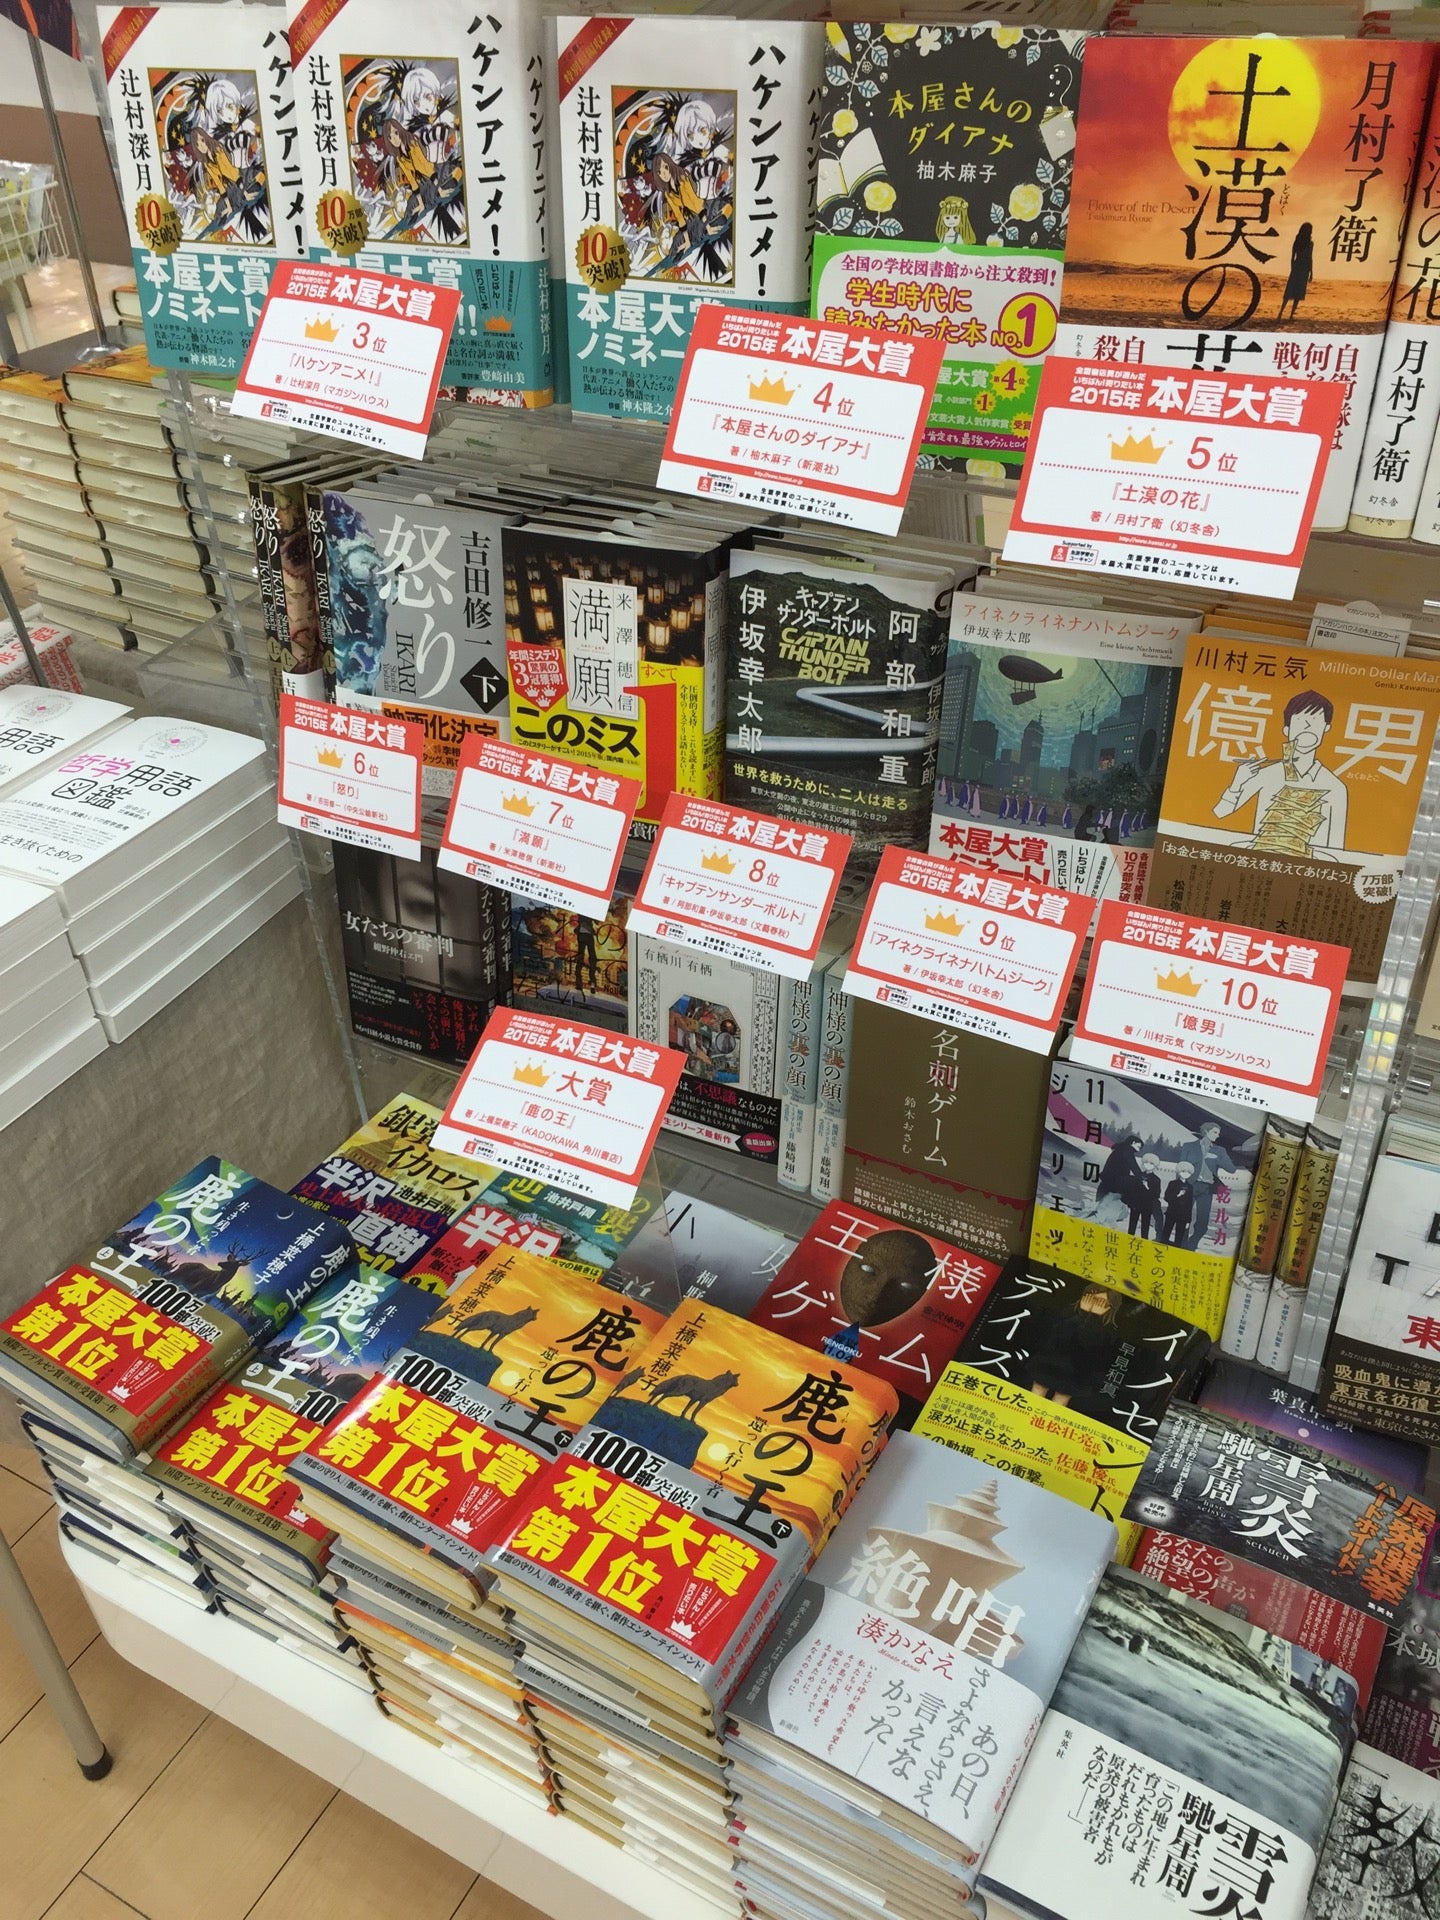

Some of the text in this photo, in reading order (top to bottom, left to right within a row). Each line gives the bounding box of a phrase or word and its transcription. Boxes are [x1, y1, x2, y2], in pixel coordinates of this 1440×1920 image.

[309, 55, 340, 187] 辻村深月
[888, 82, 1032, 124] 本屋さんの
[119, 69, 151, 191] 辻村深月
[467, 14, 506, 257] ハケンアニメ!
[526, 54, 546, 254] ハケンアニメ!
[576, 87, 604, 223] 辻村深月
[909, 121, 1015, 155] ダイアナ
[748, 45, 786, 296] ハケンアニメ!
[917, 159, 996, 183] 柚木麻子
[1328, 60, 1397, 263] 月村了衛
[1088, 200, 1197, 215] Flower of the Desert
[141, 255, 272, 297] 本屋大賞
[586, 257, 628, 286] 突破!
[841, 253, 1056, 286] 全国の学校図書館から注文殺到!
[846, 277, 972, 312] 学生時代に
[286, 277, 436, 321] 2015年 本屋大賞
[352, 322, 387, 354] 3位
[717, 326, 915, 378] 2015年 本屋大賞
[289, 352, 383, 388] 『ハケンアニメ!』
[812, 381, 855, 417] 4位
[1069, 377, 1308, 425] 2015年 本屋大賞
[1373, 339, 1428, 483] 月村了衛
[712, 413, 870, 460] 『本屋さんのダイアナ』
[1186, 436, 1238, 473] 5位
[250, 495, 265, 546] 怒り
[1111, 482, 1210, 513] 『土漠の花』
[263, 505, 281, 556] 怒り
[307, 507, 326, 559] 怒り
[259, 559, 272, 598] IKARI
[272, 568, 286, 611] IKARI
[317, 571, 329, 615] IKARI
[460, 530, 493, 647] 吉田修一
[795, 585, 860, 615] キャプテン
[375, 514, 455, 699] 怒り
[964, 602, 1180, 640] アイネクライネナハトムジーク
[508, 649, 560, 661] 年間ミステリ
[568, 586, 614, 711] 満願
[616, 591, 634, 712] 米澤穂信
[779, 642, 871, 674] THUNDER
[781, 627, 869, 656] CAPTAIN
[963, 624, 1031, 644] 伊坂幸太郎
[395, 630, 417, 697] IKARI
[471, 674, 498, 704] 下
[737, 584, 767, 755] 伊坂幸太郎
[797, 664, 849, 685] BOLT
[1196, 646, 1311, 680] 川村元気
[878, 610, 920, 785] 阿部和重
[294, 712, 406, 750] 2015年 本屋大賞
[515, 706, 641, 759] このミス
[921, 685, 942, 785] 伊坂幸太郎
[58, 753, 202, 797] 哲学用語
[353, 752, 380, 778] 6位
[479, 755, 620, 806] 2015年 本屋大賞
[733, 763, 908, 811] 世界を救うために、二人は走る
[51, 777, 133, 811] 図鑑
[549, 801, 574, 829] 7位
[681, 814, 726, 836] 2015年
[728, 815, 828, 862] 本屋大賞
[939, 823, 1048, 867] 本屋大賞
[1161, 840, 1353, 885] 「お金と幸せの答えを教えてあげよう」
[659, 873, 807, 926] 『キャプテンサンダーボルト』
[748, 858, 781, 888] 8位
[899, 870, 1070, 925] 2015年 本屋大賞
[1360, 874, 1394, 886] 7万部
[1362, 885, 1393, 898] 突破!
[344, 910, 454, 957] 女たちの審判
[979, 920, 1017, 952] 9位
[1122, 926, 1319, 980] 2015年 本屋大賞
[644, 949, 712, 977] 有栖川 有栖
[869, 929, 1055, 997] 『アイネクライネナハトムジーク』
[1221, 977, 1280, 1016] 10位
[786, 980, 813, 1091] 神様の裏の顔
[820, 987, 848, 1104] 神様の裏の顔
[1175, 1012, 1225, 1038] 『億男』
[503, 1028, 550, 1049] 2015年
[550, 1027, 661, 1079] 本屋大賞
[519, 1100, 577, 1131] 『鹿の王』
[556, 1071, 613, 1107] 大賞
[924, 1029, 959, 1167] 名刺ゲーム
[902, 1096, 916, 1154] 鈴木おさむ
[1083, 1078, 1104, 1182] 11月の
[395, 1185, 457, 1224] 池井戸潤
[543, 1191, 598, 1220] 池井戸潤
[1253, 1146, 1276, 1216] タイムマシン
[1270, 1150, 1294, 1221] ふたつの星と
[1292, 1158, 1314, 1229] タイムマシン
[1307, 1161, 1333, 1234] ふたつの星と
[91, 1172, 242, 1290] 鹿の王
[349, 1207, 430, 1264] 直樹
[1214, 1185, 1231, 1246] 乾ルカ
[254, 1221, 325, 1287] 上橋菜穂子
[449, 1256, 516, 1325] 上橋菜穂子
[12, 1303, 118, 1381] 第1位
[57, 1272, 200, 1371] 本屋大賞
[242, 1276, 384, 1403] 鹿の王
[821, 1336, 863, 1358] RENGOKU
[962, 1273, 1066, 1378] デイズ
[640, 1312, 705, 1392] 上橋菜穂子
[1100, 1343, 1136, 1398] 早見和真
[496, 1306, 641, 1456] 鹿の王
[944, 1370, 1034, 1410] 圧巻でした。
[364, 1385, 541, 1498] 本屋大賞
[928, 1410, 1053, 1463] 涙が止まらなかった。
[1090, 1329, 1188, 1523] イノセント
[171, 1428, 286, 1505] 第1位
[319, 1420, 450, 1512] 第1位
[702, 1370, 854, 1550] 鹿の王
[1200, 1431, 1256, 1506] 馳星周
[1231, 1446, 1331, 1559] 雪炎
[555, 1461, 760, 1598] 本屋大賞
[1246, 1539, 1290, 1561] setsuen
[1358, 1495, 1437, 1607] 原発選挙
[512, 1506, 663, 1613] 第1位
[837, 1535, 1026, 1668] 絶唱
[1367, 1601, 1394, 1620] 集英社
[856, 1612, 956, 1681] 湊かなえ
[888, 1691, 947, 1782] 言えな
[914, 1664, 997, 1820] さよならさえ、
[1056, 1729, 1074, 1760] 集英社
[950, 1725, 999, 1820] あの日、
[1082, 1752, 1130, 1847] 原発の被害者
[1093, 1761, 1145, 1867] だれもかれもが
[1120, 1771, 1161, 1853] 育ったものは
[1129, 1777, 1181, 1889] 「この地に生まれ
[1156, 1790, 1217, 1900] 馳星周
